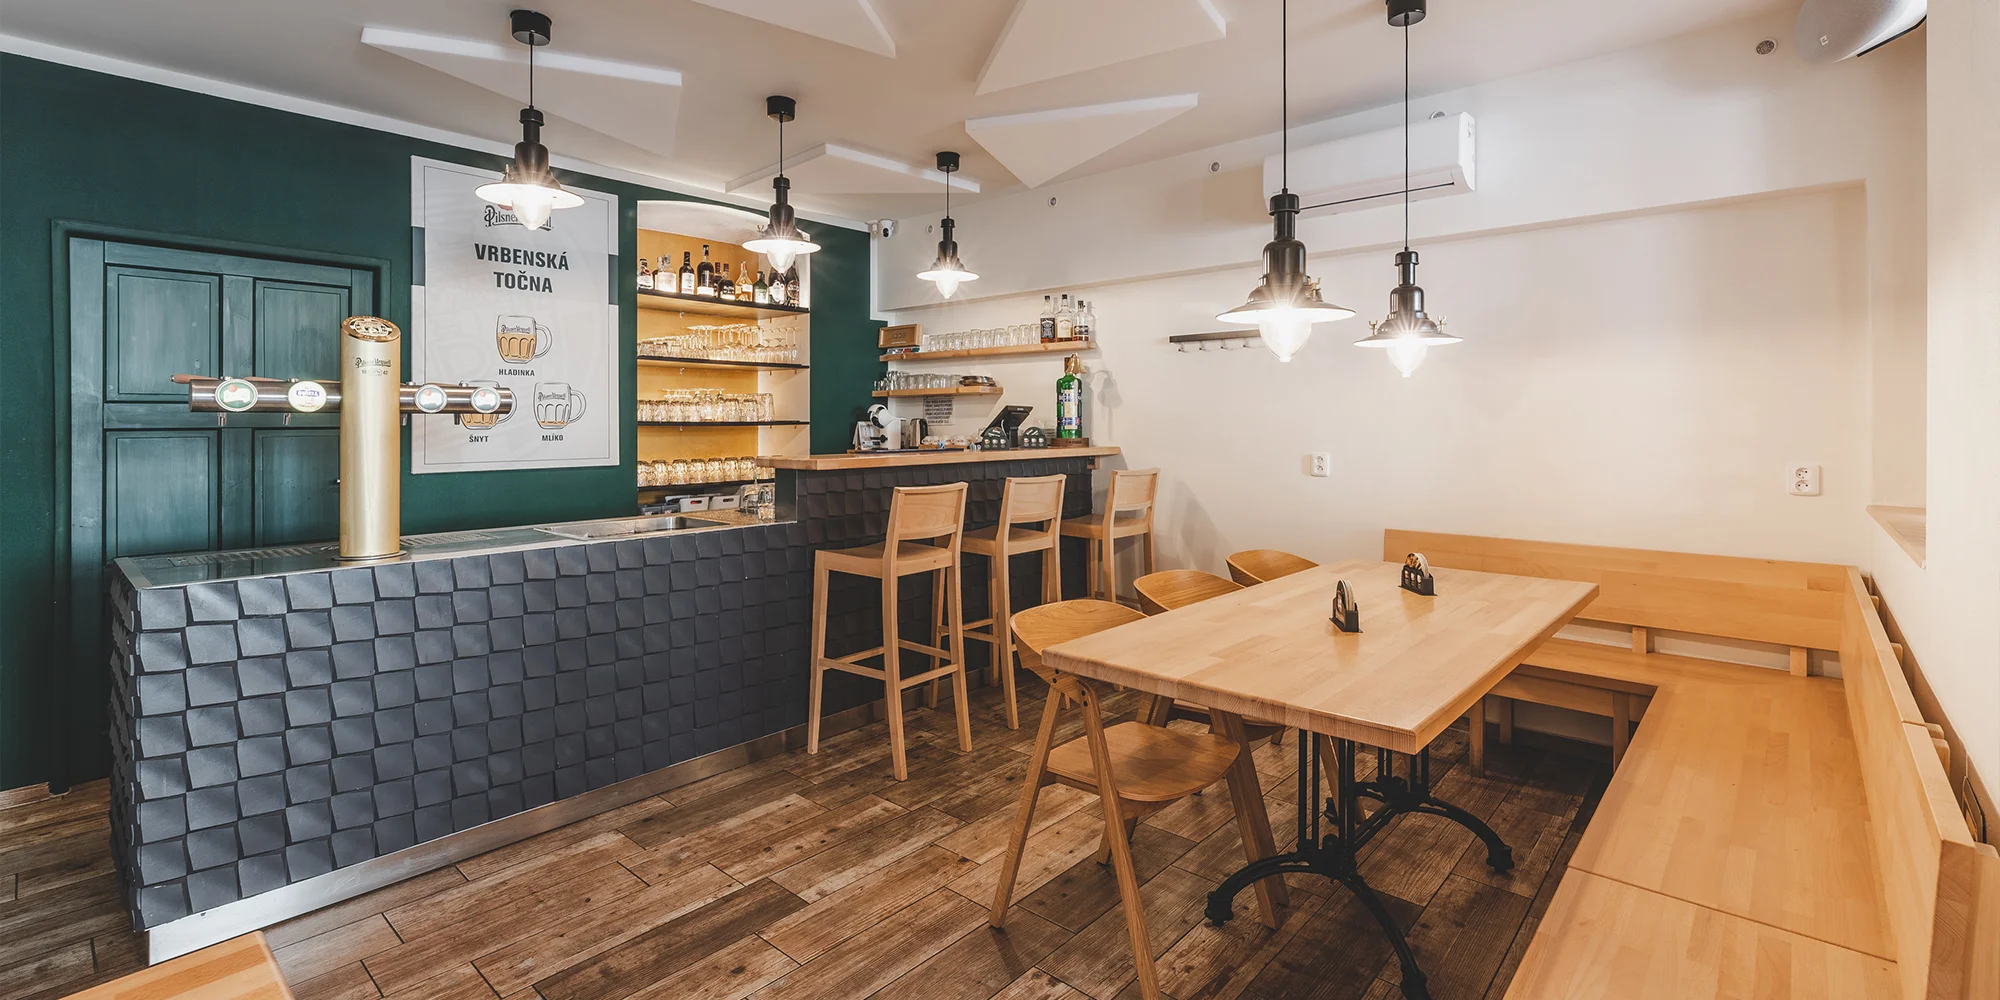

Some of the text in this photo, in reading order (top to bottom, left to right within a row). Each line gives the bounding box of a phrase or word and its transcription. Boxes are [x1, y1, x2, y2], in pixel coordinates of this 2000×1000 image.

[474, 243, 569, 271] VRBENSKÁ
[493, 270, 553, 293] TOČNA
[498, 368, 535, 377] HLADINKA
[469, 434, 489, 443] ŠNYT
[541, 433, 564, 442] MLÍKO
